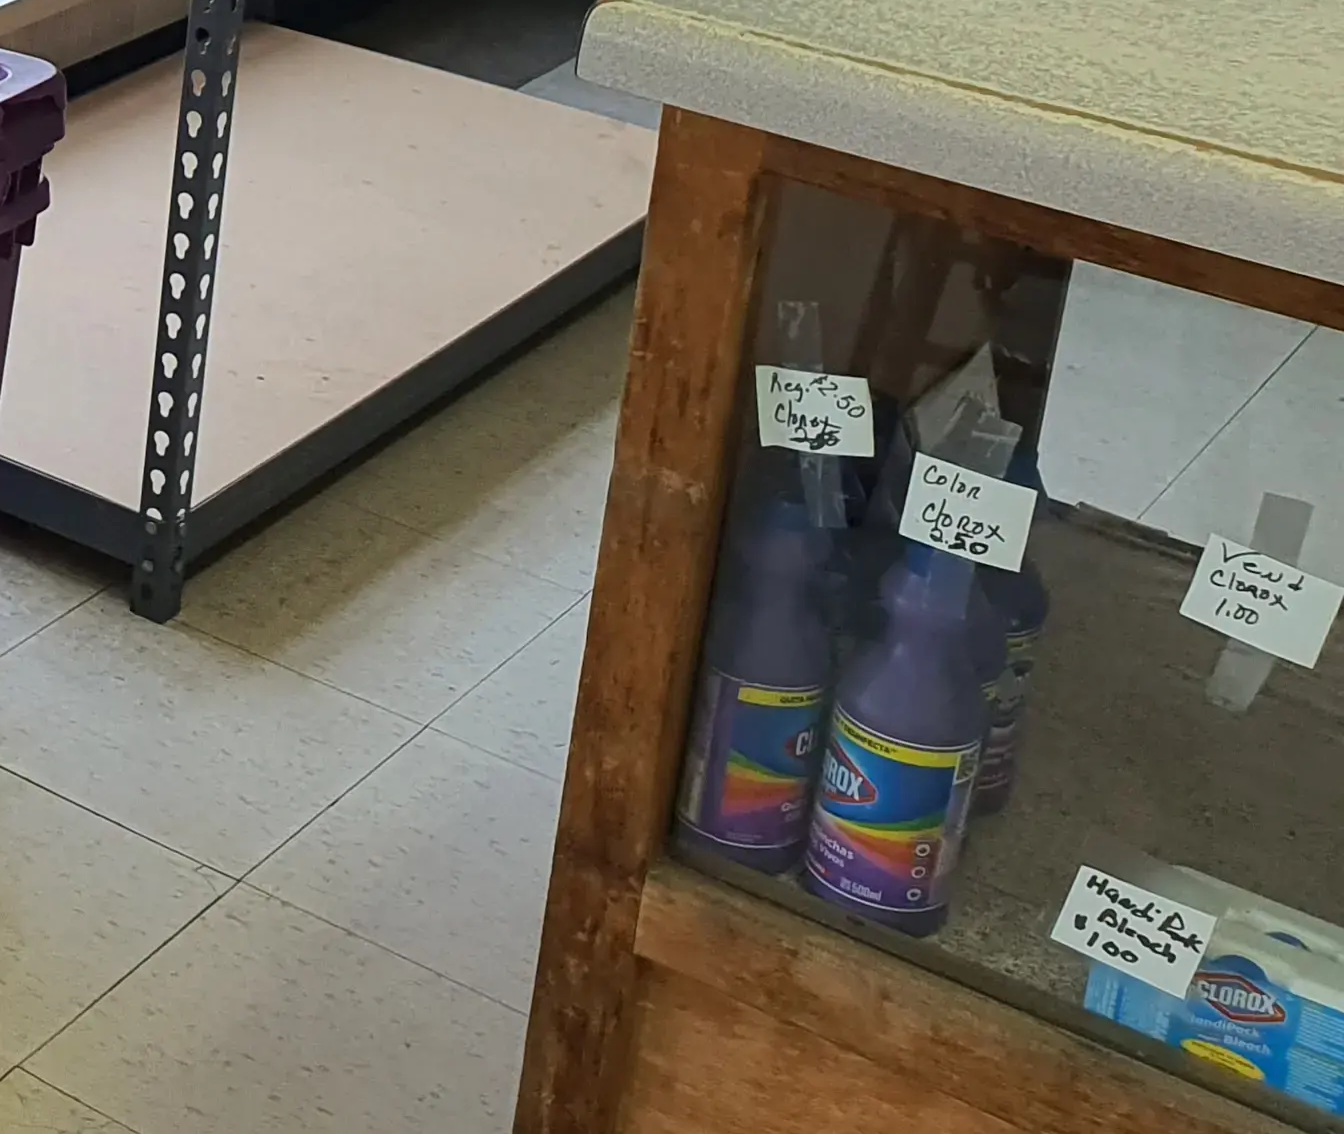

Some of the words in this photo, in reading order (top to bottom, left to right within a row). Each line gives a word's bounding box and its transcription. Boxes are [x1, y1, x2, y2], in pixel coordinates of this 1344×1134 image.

[929, 526, 989, 555] 2.50
[1215, 597, 1260, 625] 1.00
[851, 881, 882, 902] 500ml
[1196, 980, 1279, 1016] CLOROX
[1223, 1034, 1272, 1057] Bleach
